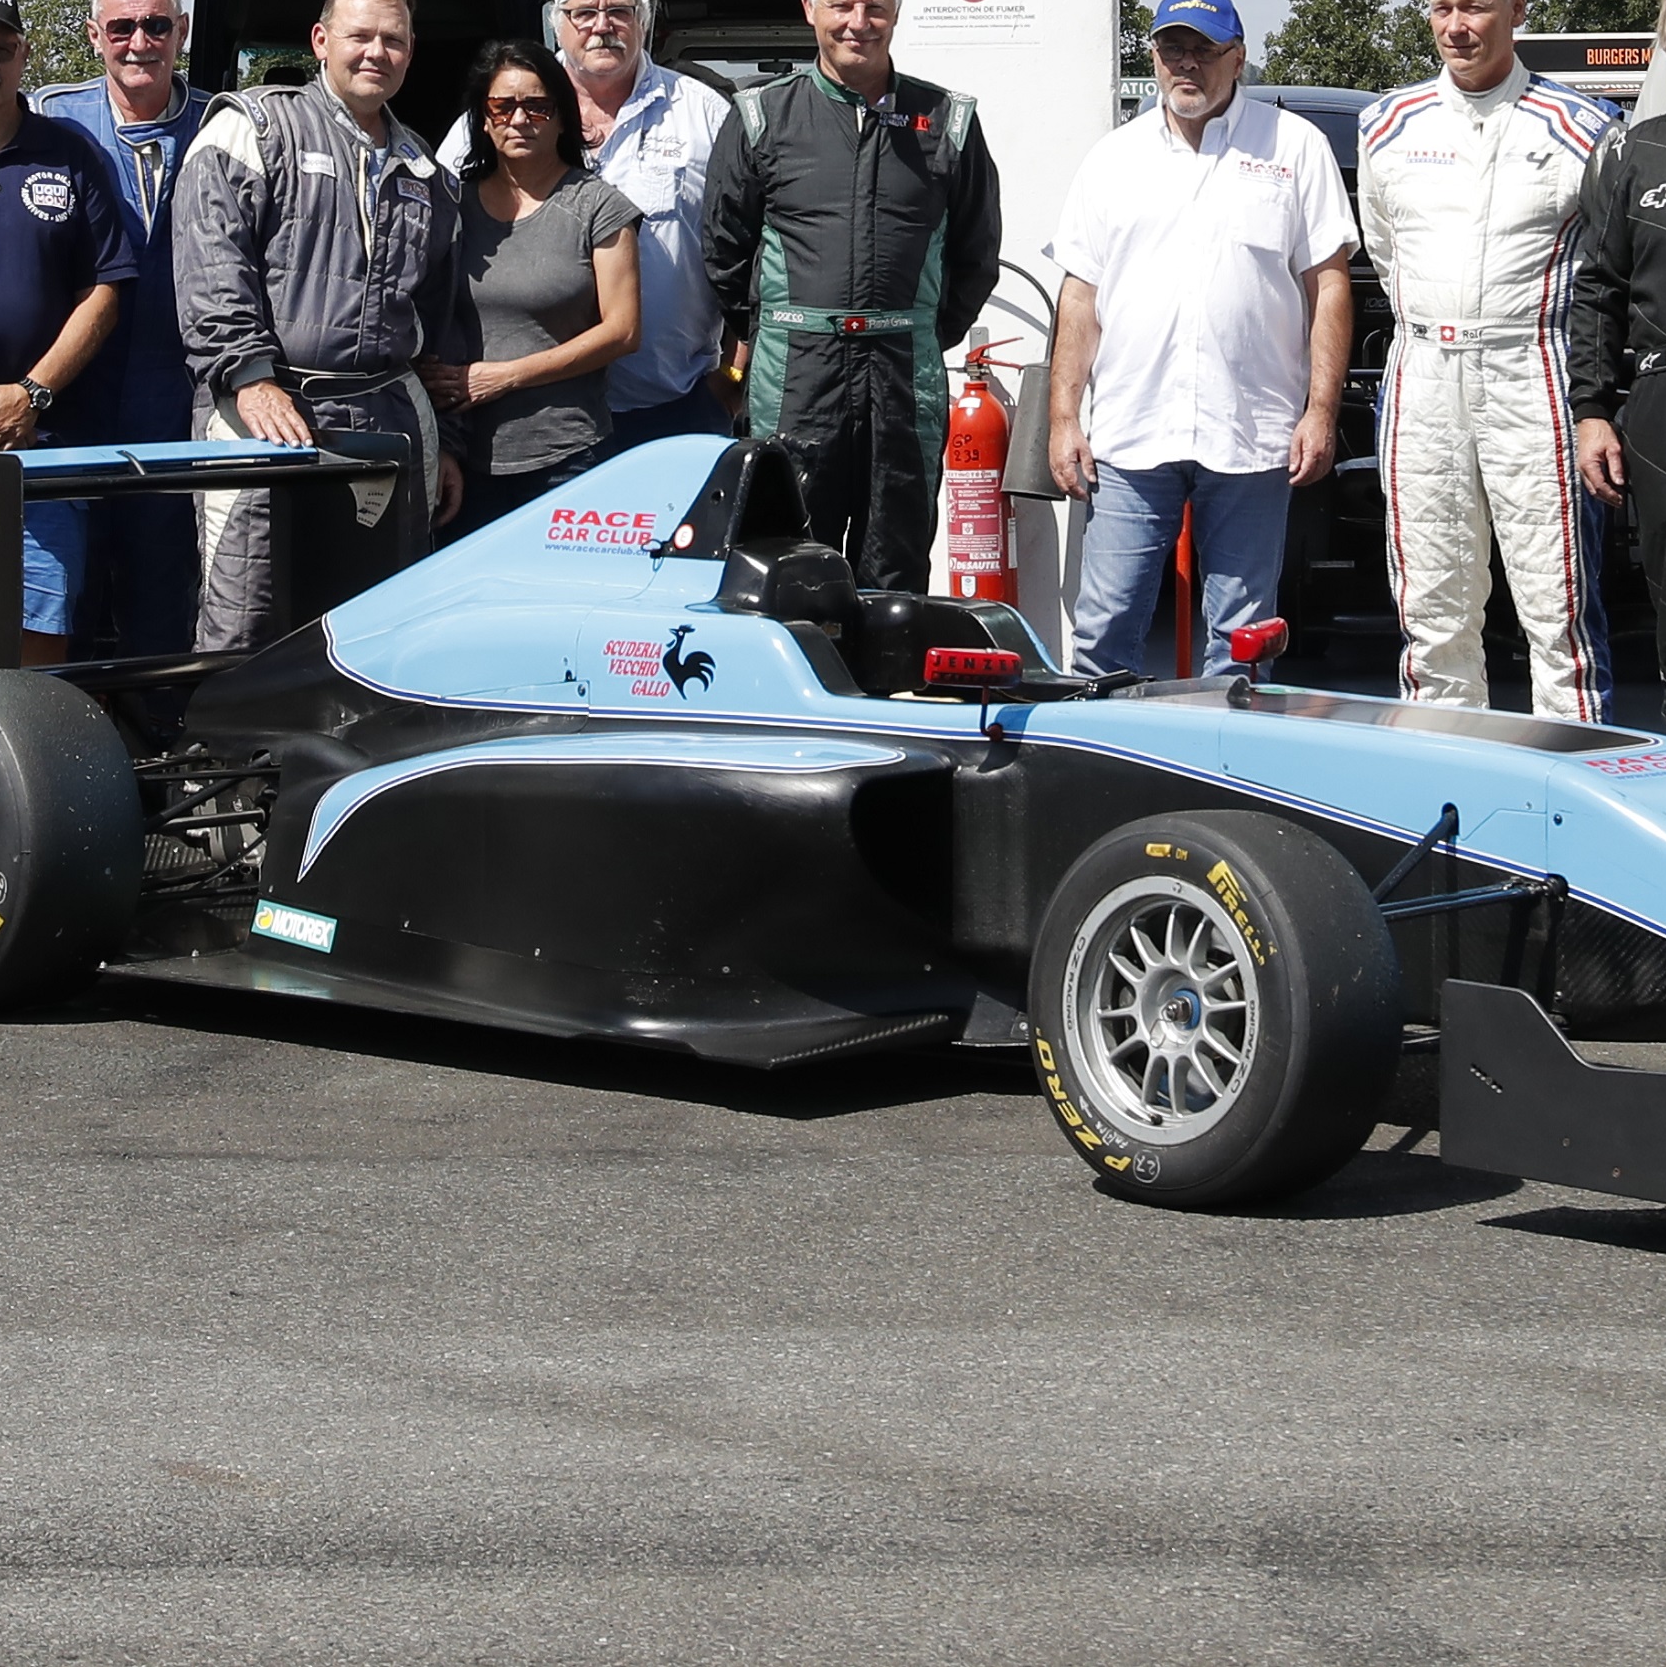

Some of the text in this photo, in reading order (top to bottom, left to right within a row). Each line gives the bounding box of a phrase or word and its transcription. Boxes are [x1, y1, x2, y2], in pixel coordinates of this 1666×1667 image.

[923, 5, 1026, 14] INTERDICTION DE FUMER
[1586, 48, 1639, 65] BURGERS
[1526, 151, 1552, 170] 4
[951, 433, 973, 449] GP
[952, 448, 980, 463] 239
[550, 508, 657, 529] RACE
[547, 526, 653, 546] CAR CLUB
[955, 560, 1001, 571] DESAUTEL
[602, 639, 663, 659] SCUDERIA
[608, 658, 661, 678] VECCHIO
[630, 679, 671, 698] GALLO
[1600, 761, 1648, 776] CAR
[1205, 859, 1267, 967] PIRELLI
[270, 908, 335, 948] MOTOREX
[1063, 972, 1076, 1032] RACING
[1242, 999, 1257, 1057] RACING
[1036, 1037, 1103, 1152] ZERO
[1104, 1153, 1132, 1172] P
